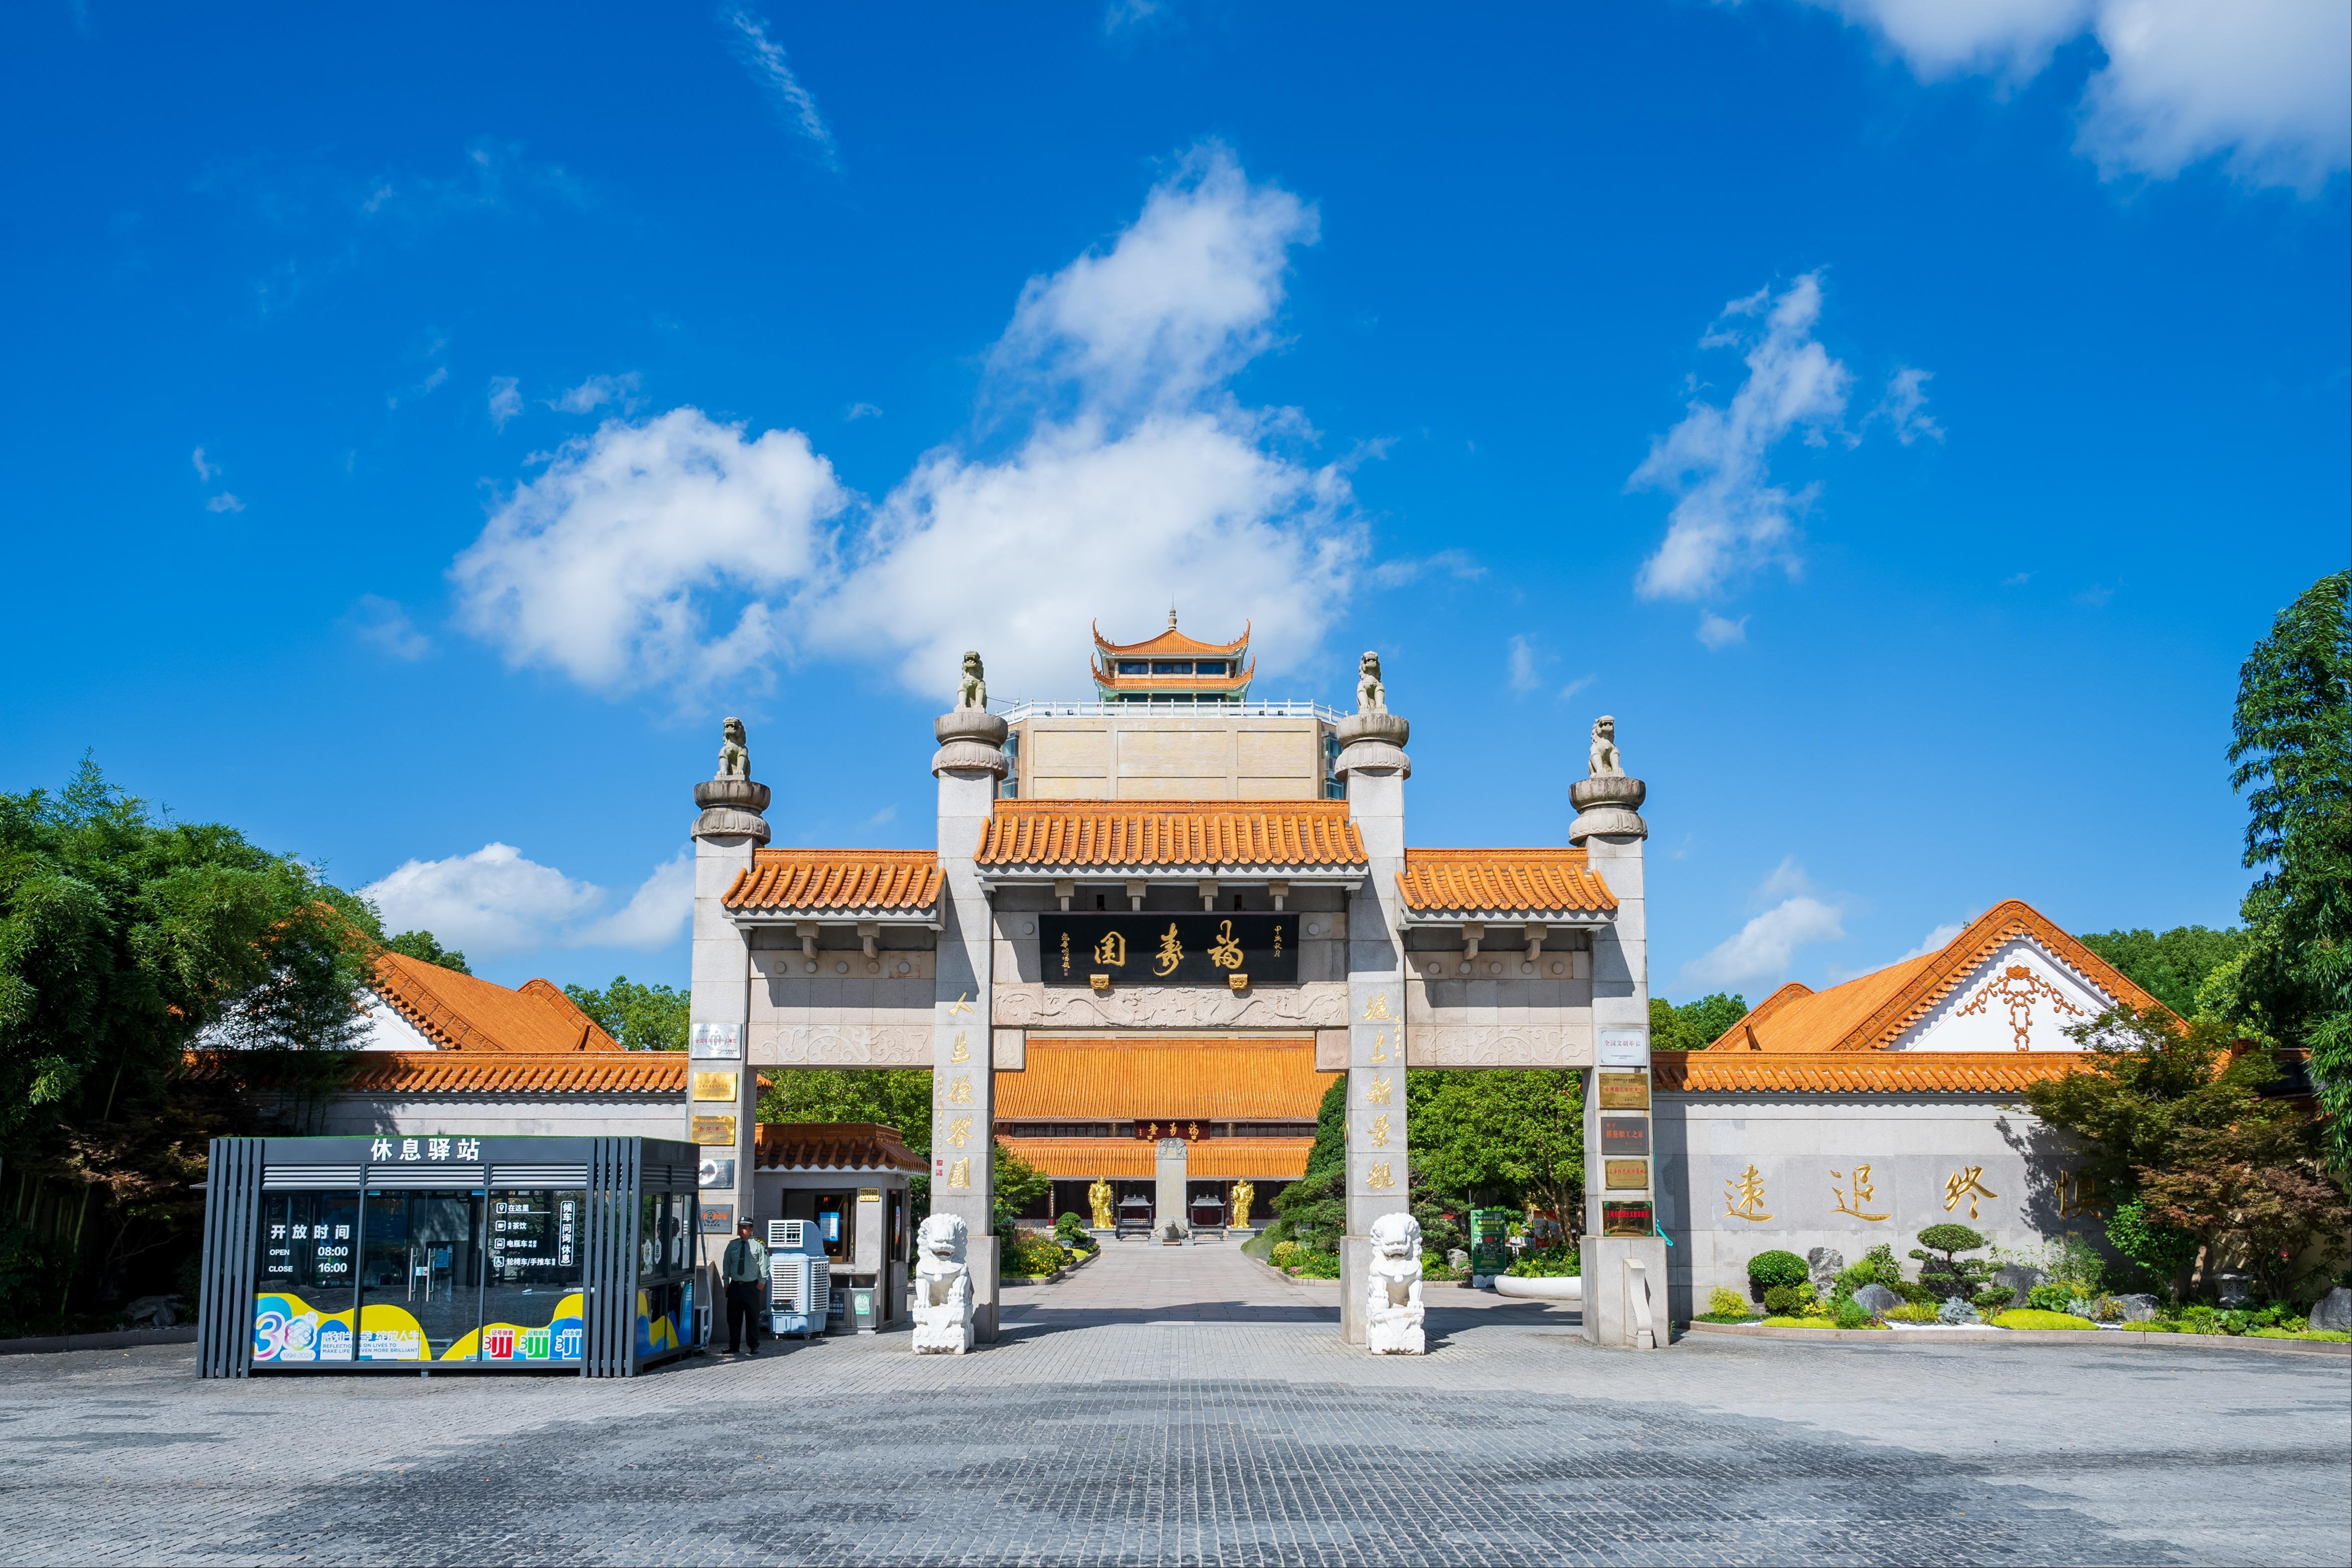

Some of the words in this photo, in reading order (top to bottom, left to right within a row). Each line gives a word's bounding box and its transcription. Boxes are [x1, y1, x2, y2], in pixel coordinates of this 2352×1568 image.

[370, 1138, 481, 1161] 休息驿站
[508, 1204, 529, 1212] 在这里
[562, 1203, 573, 1222] 候车
[271, 1224, 350, 1239] 开放时间
[562, 1224, 572, 1243] 问询
[317, 1246, 348, 1256] 08:00
[561, 1245, 571, 1264] 休息
[318, 1263, 347, 1273] 16:00
